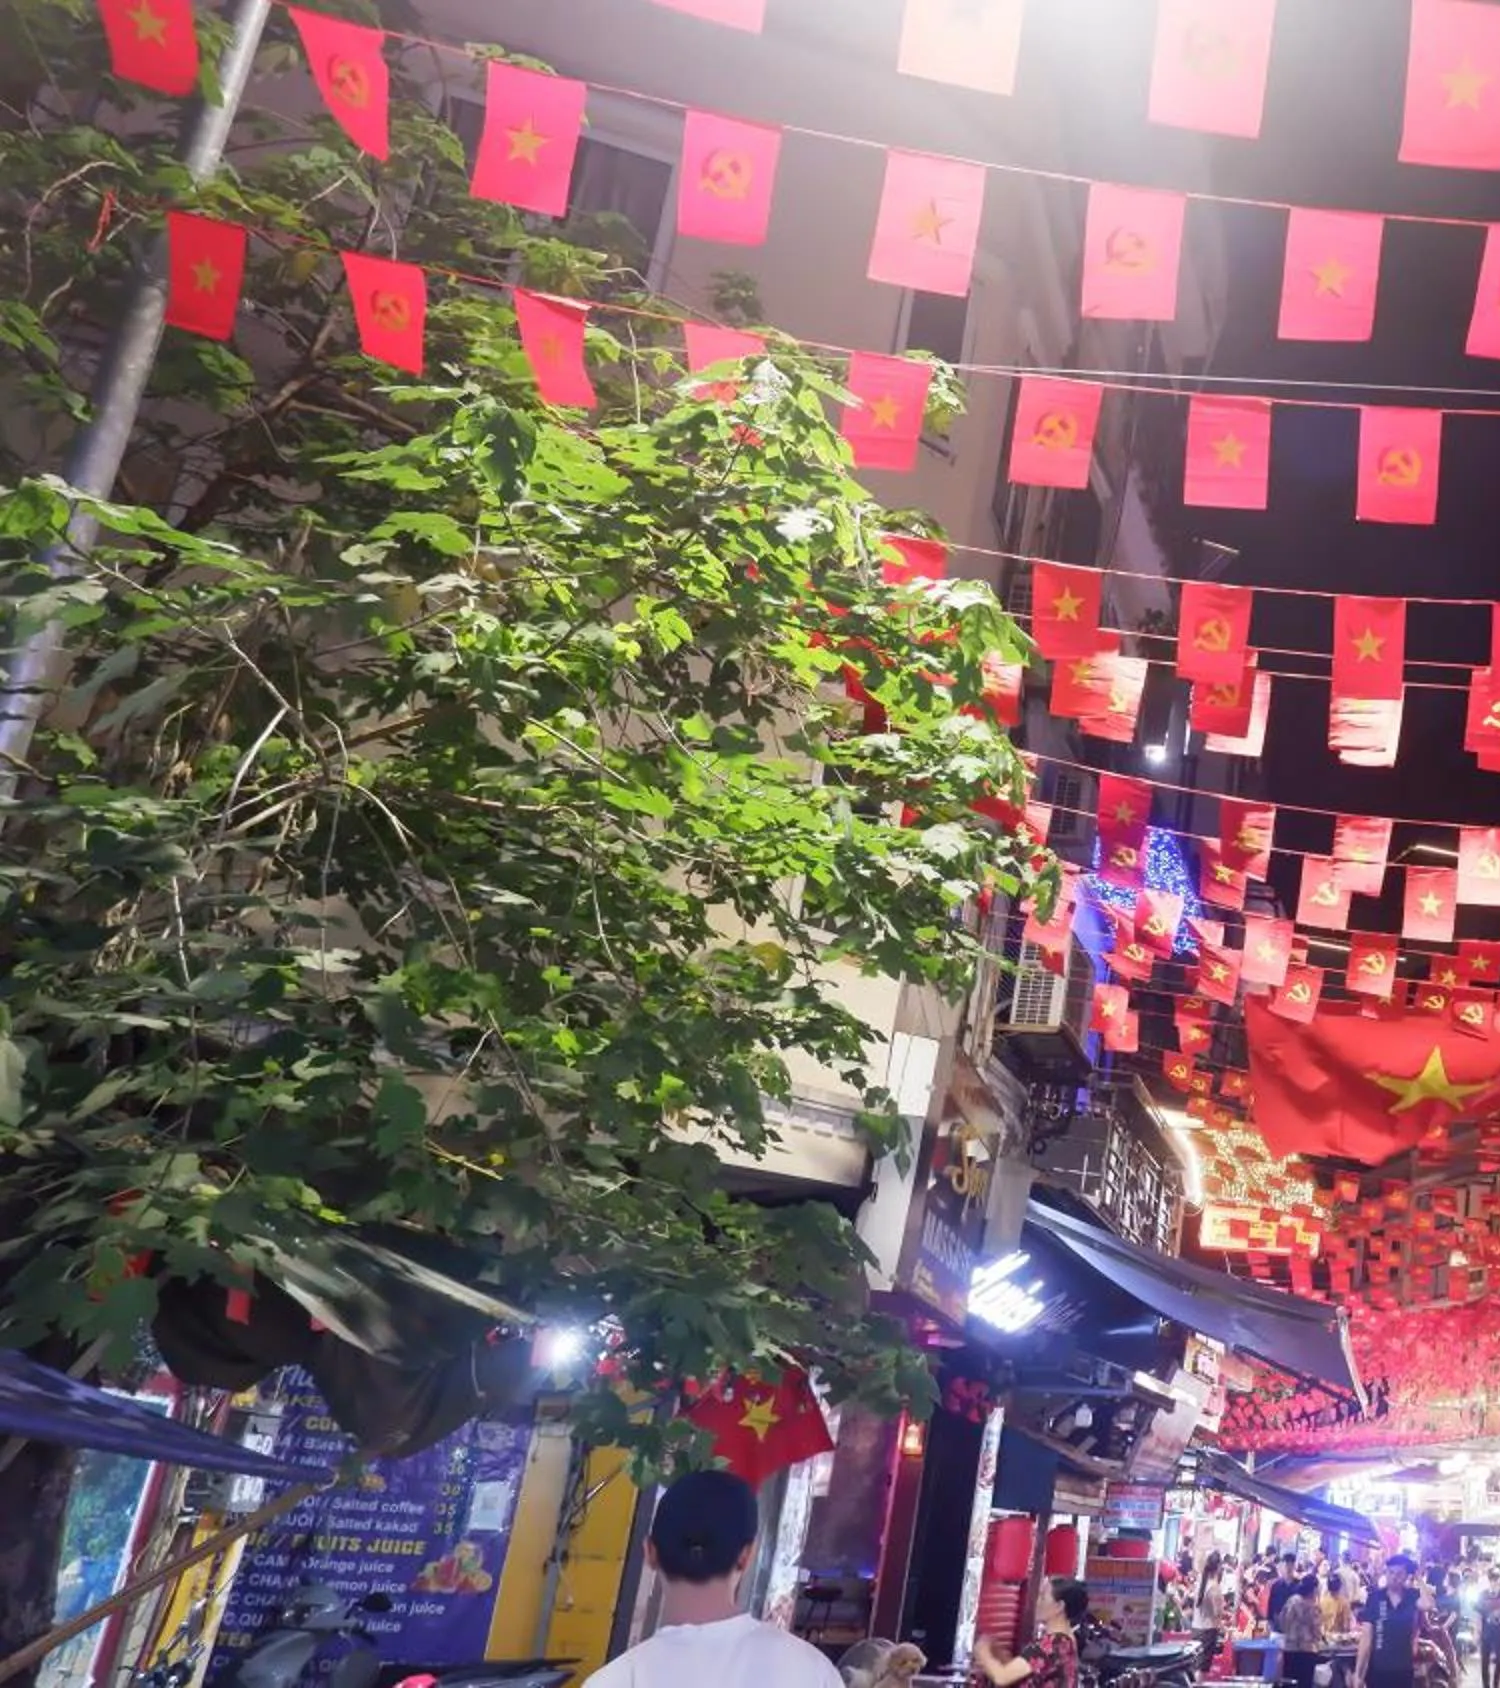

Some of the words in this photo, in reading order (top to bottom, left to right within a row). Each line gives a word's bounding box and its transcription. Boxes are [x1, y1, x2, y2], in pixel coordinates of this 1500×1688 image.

[331, 1497, 377, 1513] Salted
[381, 1500, 426, 1515] coffee
[366, 1539, 427, 1556] JUICE
[358, 1558, 395, 1574] juice
[370, 1577, 407, 1594] juice
[408, 1601, 446, 1617] juice
